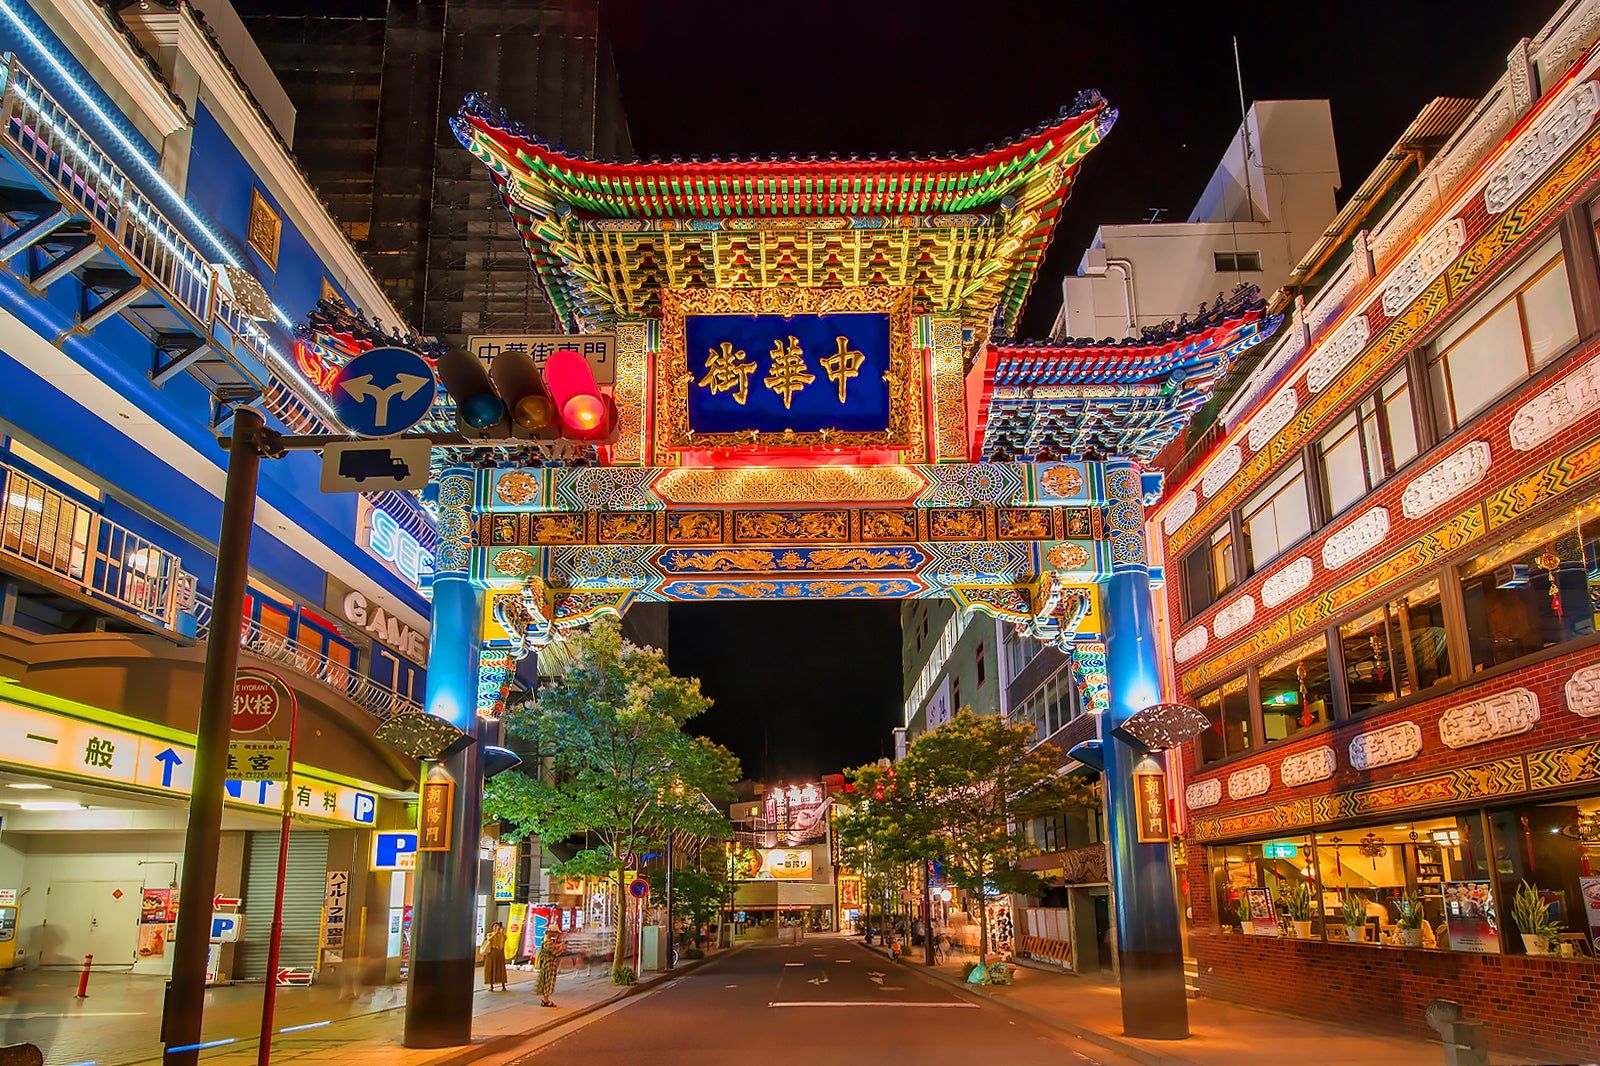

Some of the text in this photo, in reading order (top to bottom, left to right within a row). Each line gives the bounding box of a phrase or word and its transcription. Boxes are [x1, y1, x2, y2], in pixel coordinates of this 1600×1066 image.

[697, 335, 866, 410] 中華街
[344, 590, 425, 663] GAME
[26, 732, 115, 770] 一般
[296, 784, 338, 813] 有料
[425, 786, 443, 843] 朝陽門
[1144, 776, 1163, 833] 朝陽門
[376, 834, 417, 866] P
[211, 918, 234, 937] P
[326, 872, 347, 945] ハイルーフ車 空車
